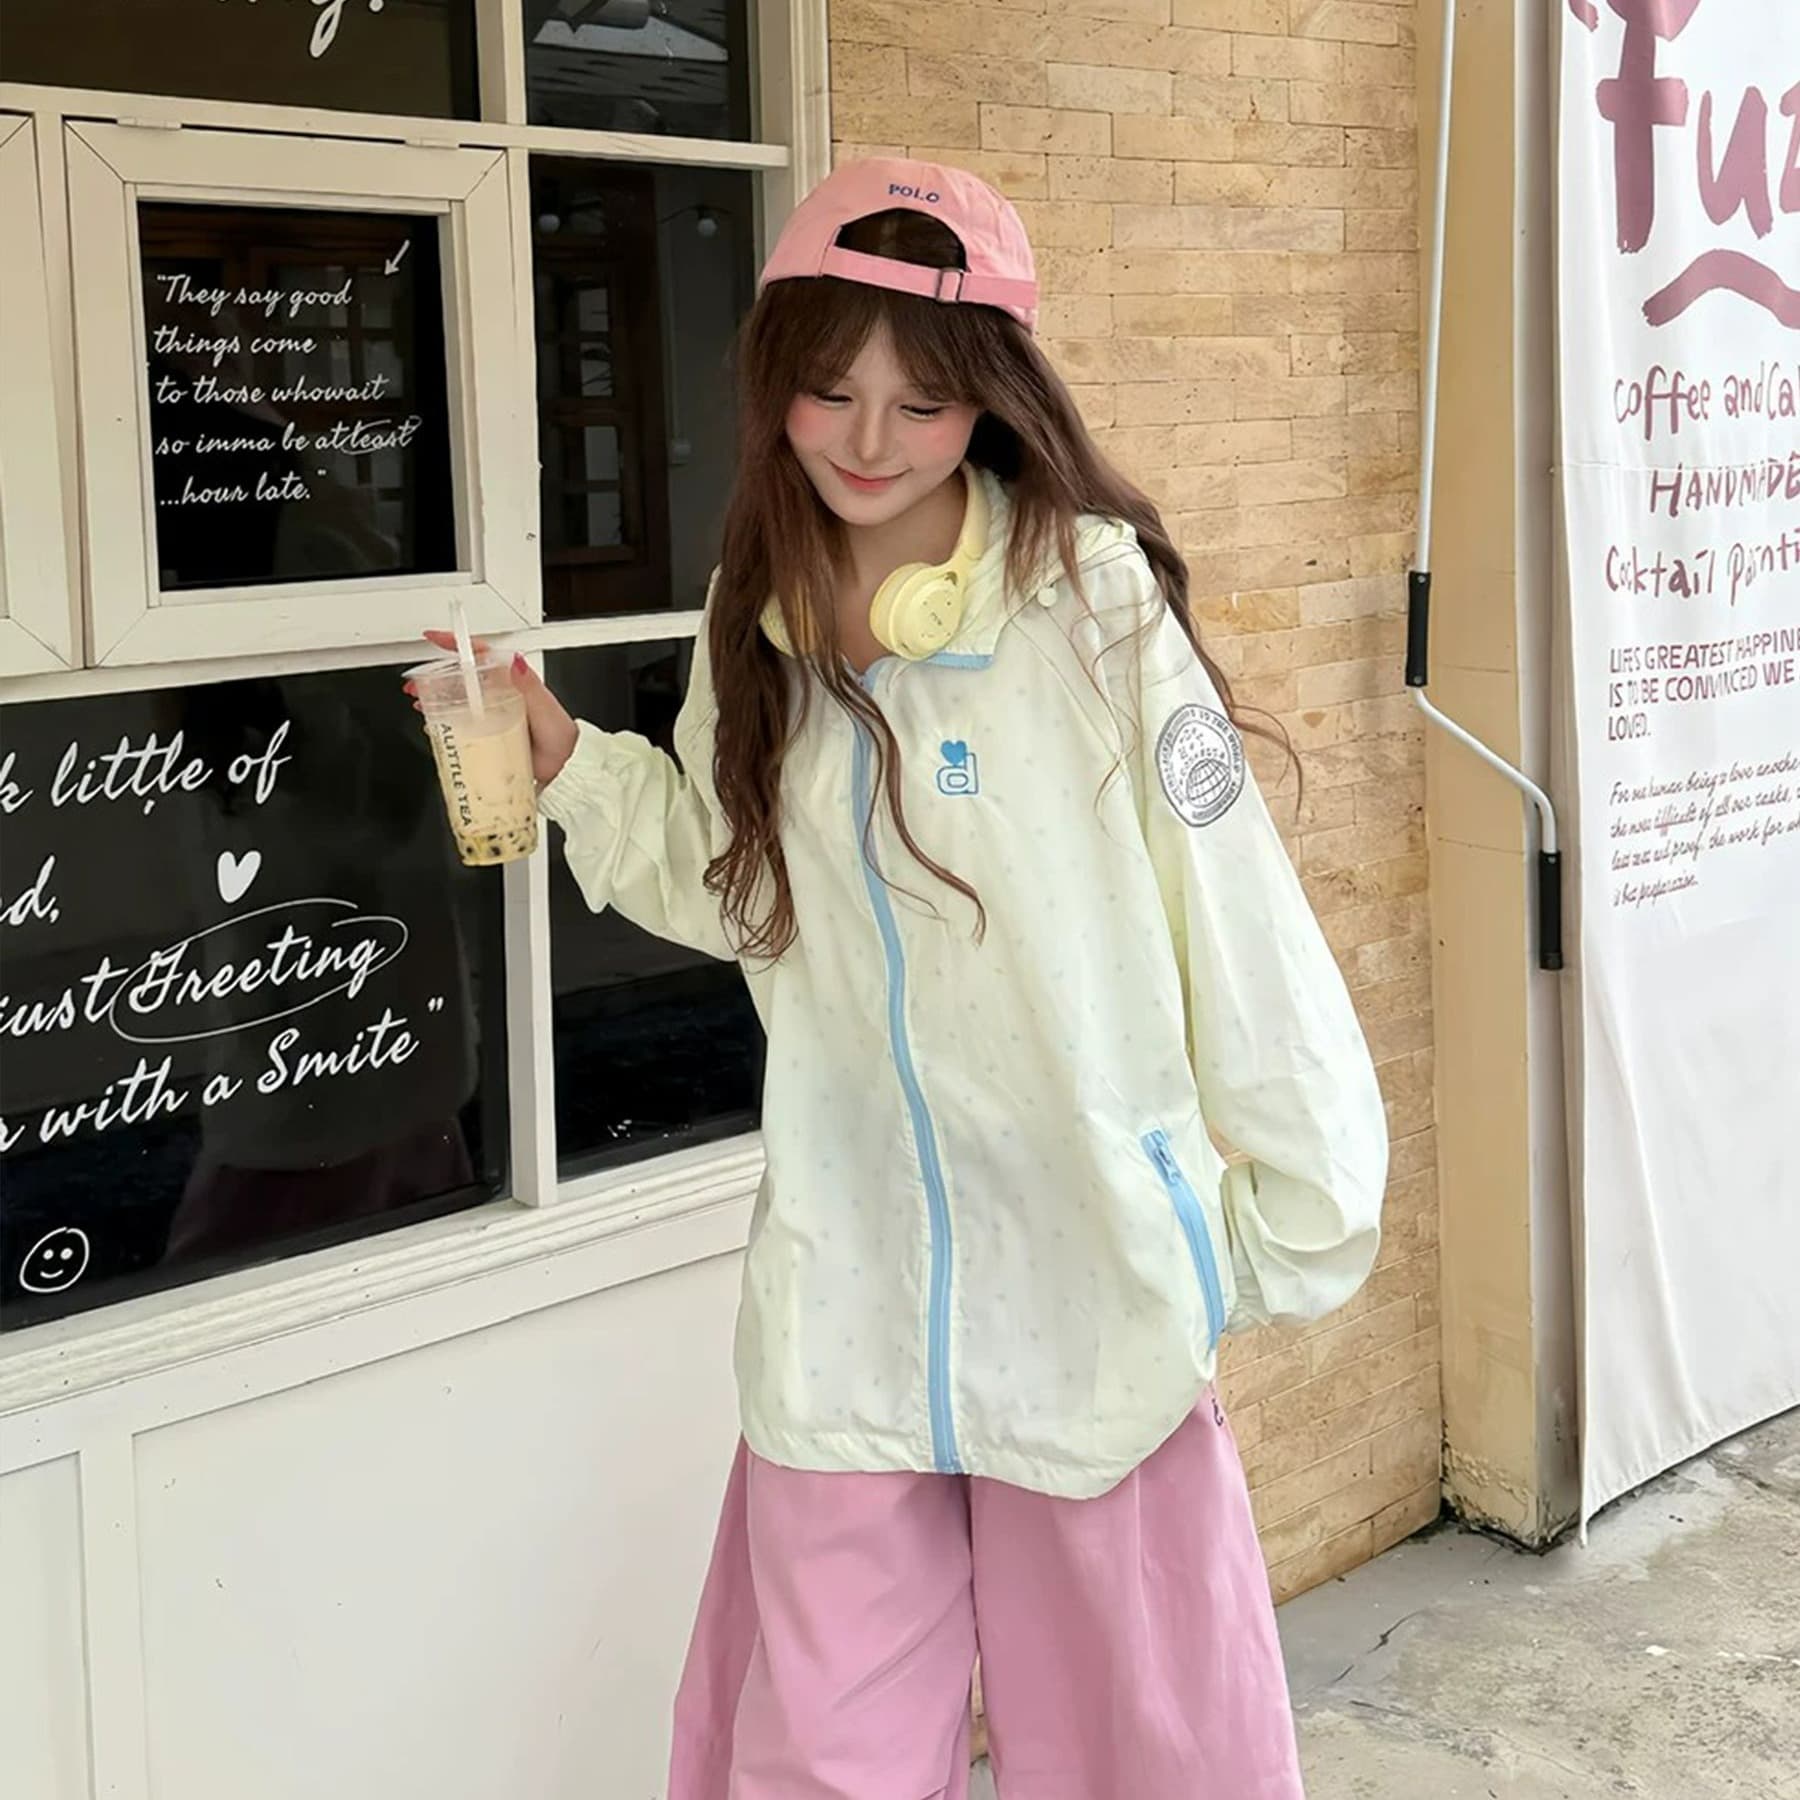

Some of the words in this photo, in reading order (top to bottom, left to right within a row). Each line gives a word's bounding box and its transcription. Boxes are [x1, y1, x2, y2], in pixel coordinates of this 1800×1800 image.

[887, 183, 940, 203] POLO
[157, 274, 230, 317] "They
[233, 287, 284, 317] say
[289, 278, 352, 318] good
[153, 325, 241, 367] things
[250, 337, 318, 354] come
[155, 376, 189, 404] to
[192, 375, 266, 403] those
[1723, 360, 1764, 419] and
[1766, 361, 1800, 420] Ca
[155, 437, 190, 455] so
[196, 434, 276, 453] imma
[281, 421, 310, 450] be
[1645, 639, 1734, 669] GREATEST
[1609, 683, 1624, 708] IS
[1641, 678, 1659, 704] BE
[1762, 659, 1795, 687] WE
[228, 719, 293, 804] of
[458, 793, 472, 826] TEA
[0, 854, 59, 924] d,
[39, 1055, 189, 1143] with
[202, 1073, 244, 1106] a
